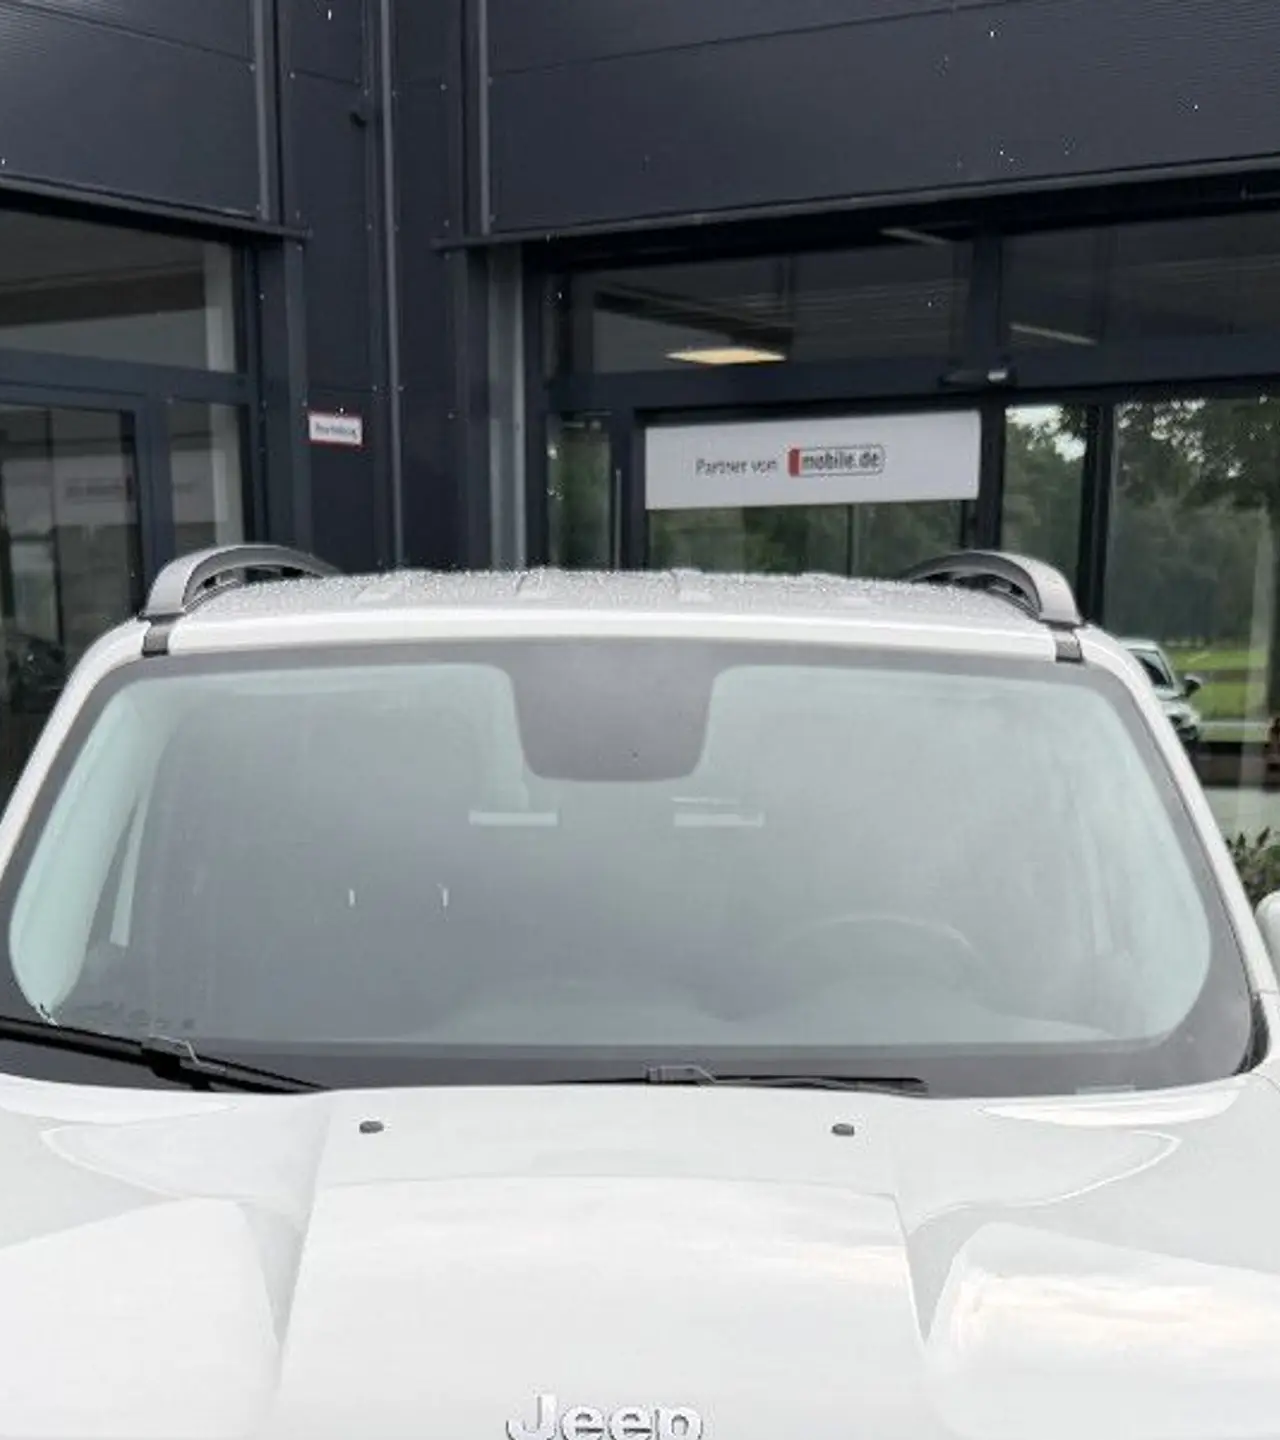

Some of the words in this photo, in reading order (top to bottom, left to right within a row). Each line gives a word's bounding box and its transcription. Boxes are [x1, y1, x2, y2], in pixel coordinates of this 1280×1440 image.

[695, 457, 747, 475] Partner
[751, 459, 778, 474] von
[802, 451, 880, 470] mobile.de
